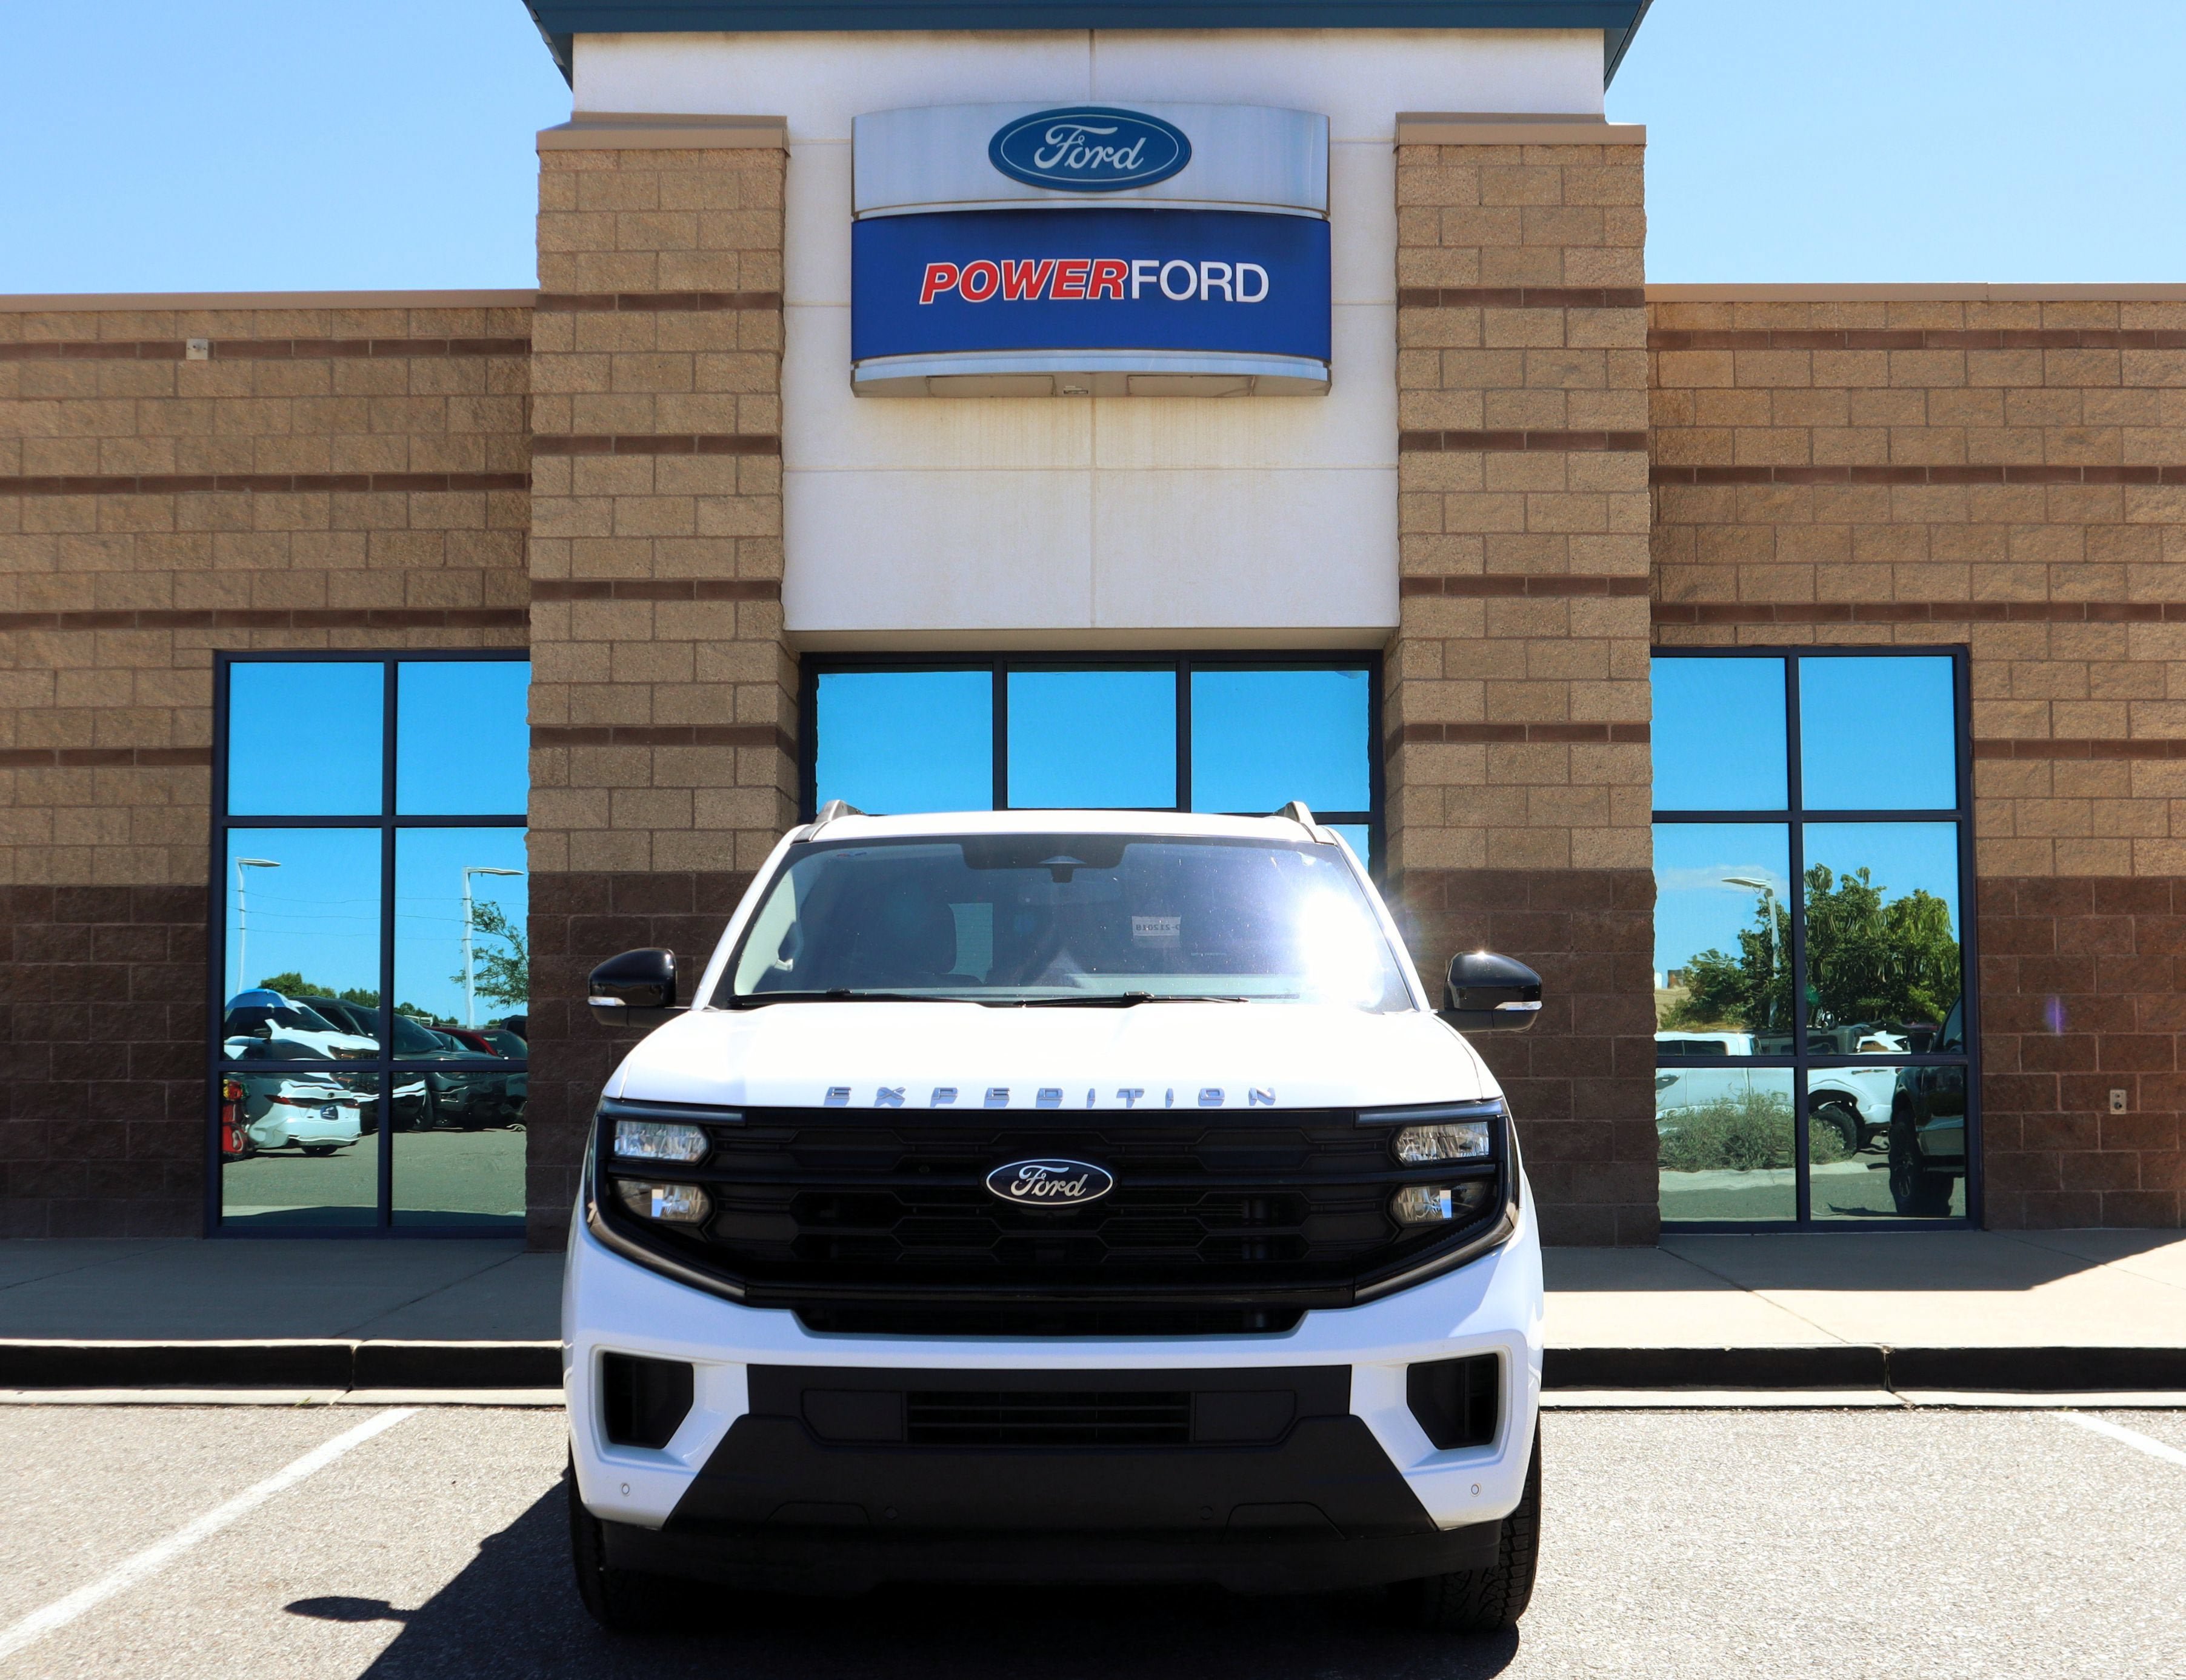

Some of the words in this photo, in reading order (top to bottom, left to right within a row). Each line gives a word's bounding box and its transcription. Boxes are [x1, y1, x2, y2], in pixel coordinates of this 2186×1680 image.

[1033, 123, 1146, 171] Ford
[919, 258, 1270, 305] POWERFORD
[825, 1086, 1276, 1104] EXPEDITION
[1010, 1165, 1088, 1197] Ford
